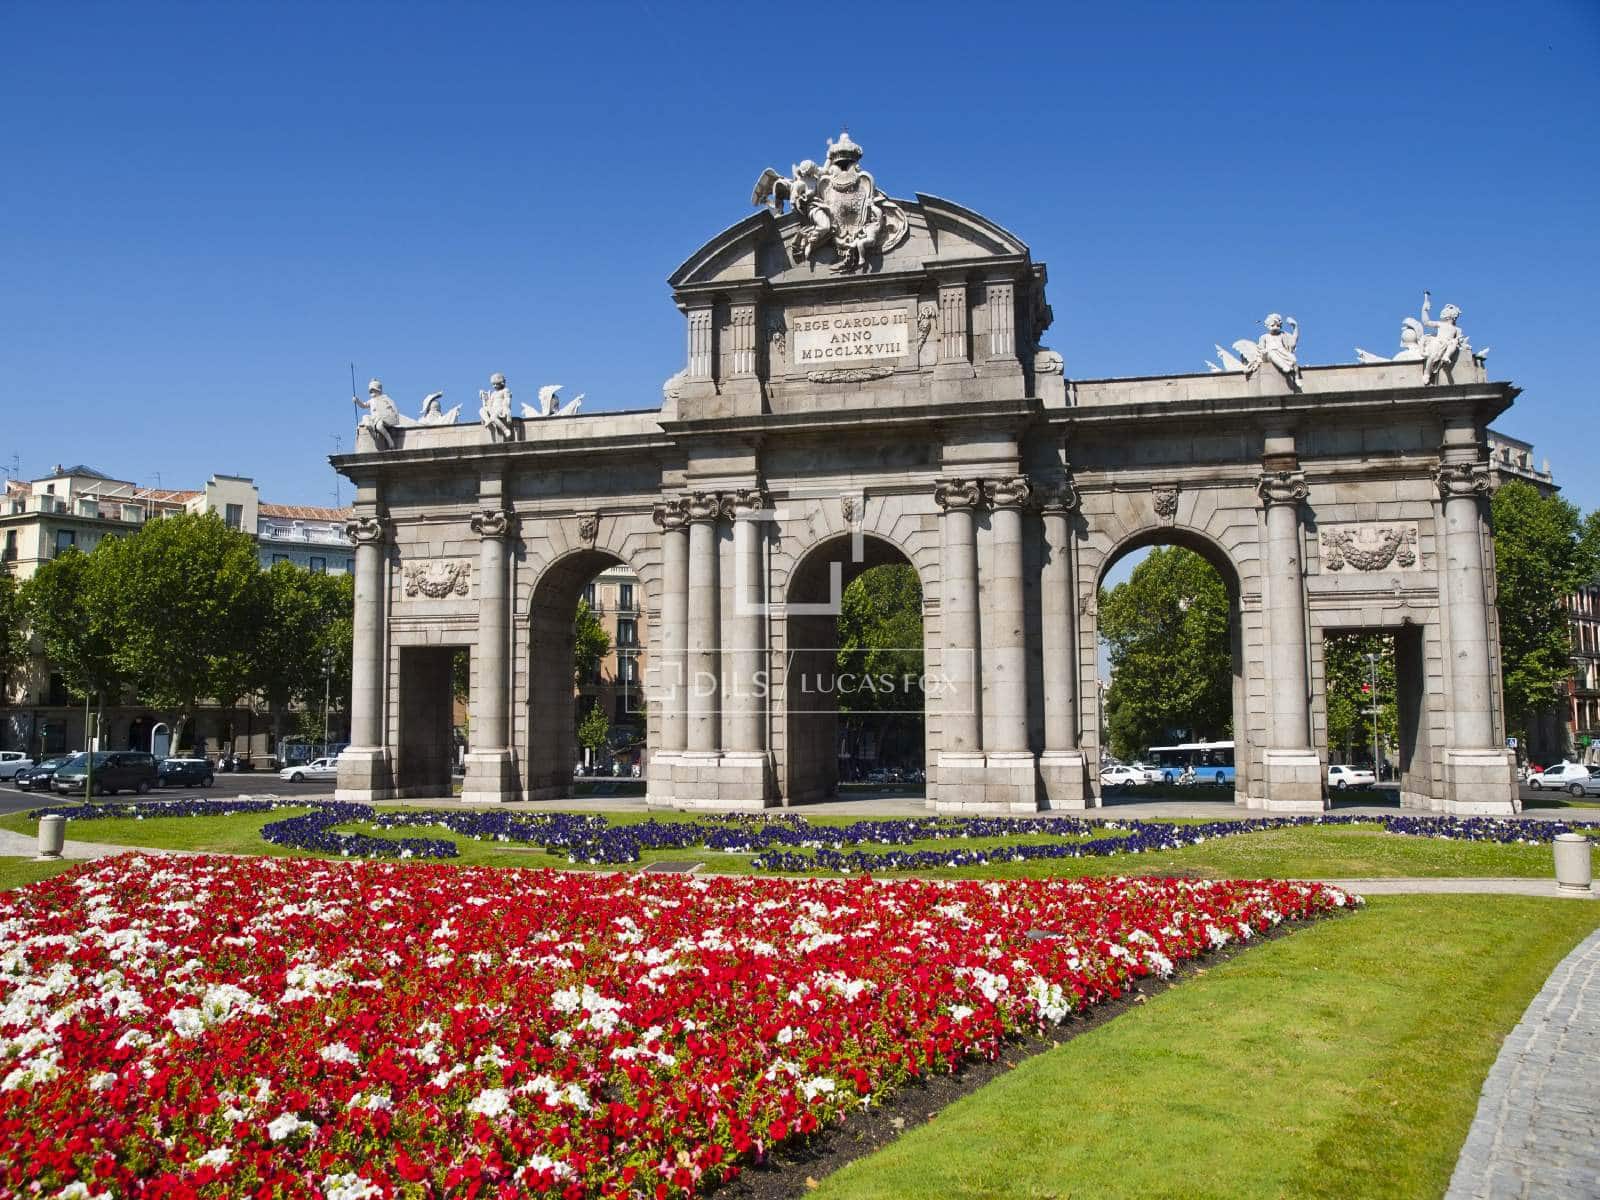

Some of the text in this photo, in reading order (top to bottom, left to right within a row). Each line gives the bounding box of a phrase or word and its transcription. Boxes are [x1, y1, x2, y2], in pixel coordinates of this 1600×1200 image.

[794, 313, 907, 333] REGE CAROLO III
[830, 330, 872, 343] ANNO
[802, 342, 901, 359] MDCCLXXVIII
